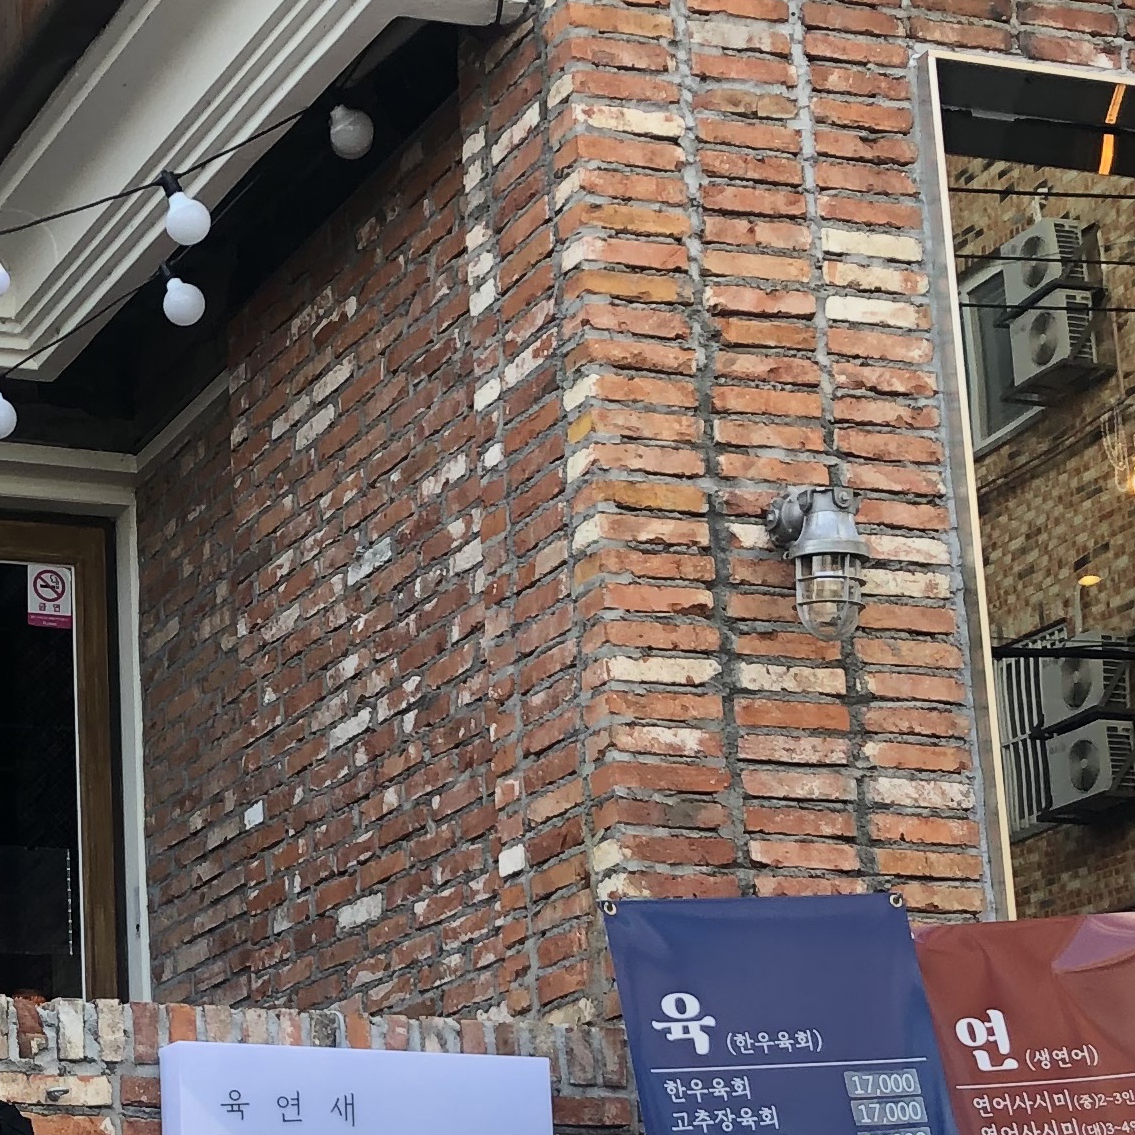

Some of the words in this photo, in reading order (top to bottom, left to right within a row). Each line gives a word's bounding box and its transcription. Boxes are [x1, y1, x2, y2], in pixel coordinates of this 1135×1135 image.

[651, 992, 716, 1056] 육
[726, 1029, 823, 1056] (한우육회)
[955, 1009, 1019, 1071] 연
[1025, 1044, 1099, 1072] (생연어)
[664, 1076, 751, 1103] 한우육회
[851, 1073, 915, 1096] 17,000
[671, 1105, 780, 1133] 고추장육회
[858, 1101, 922, 1124] 17,000
